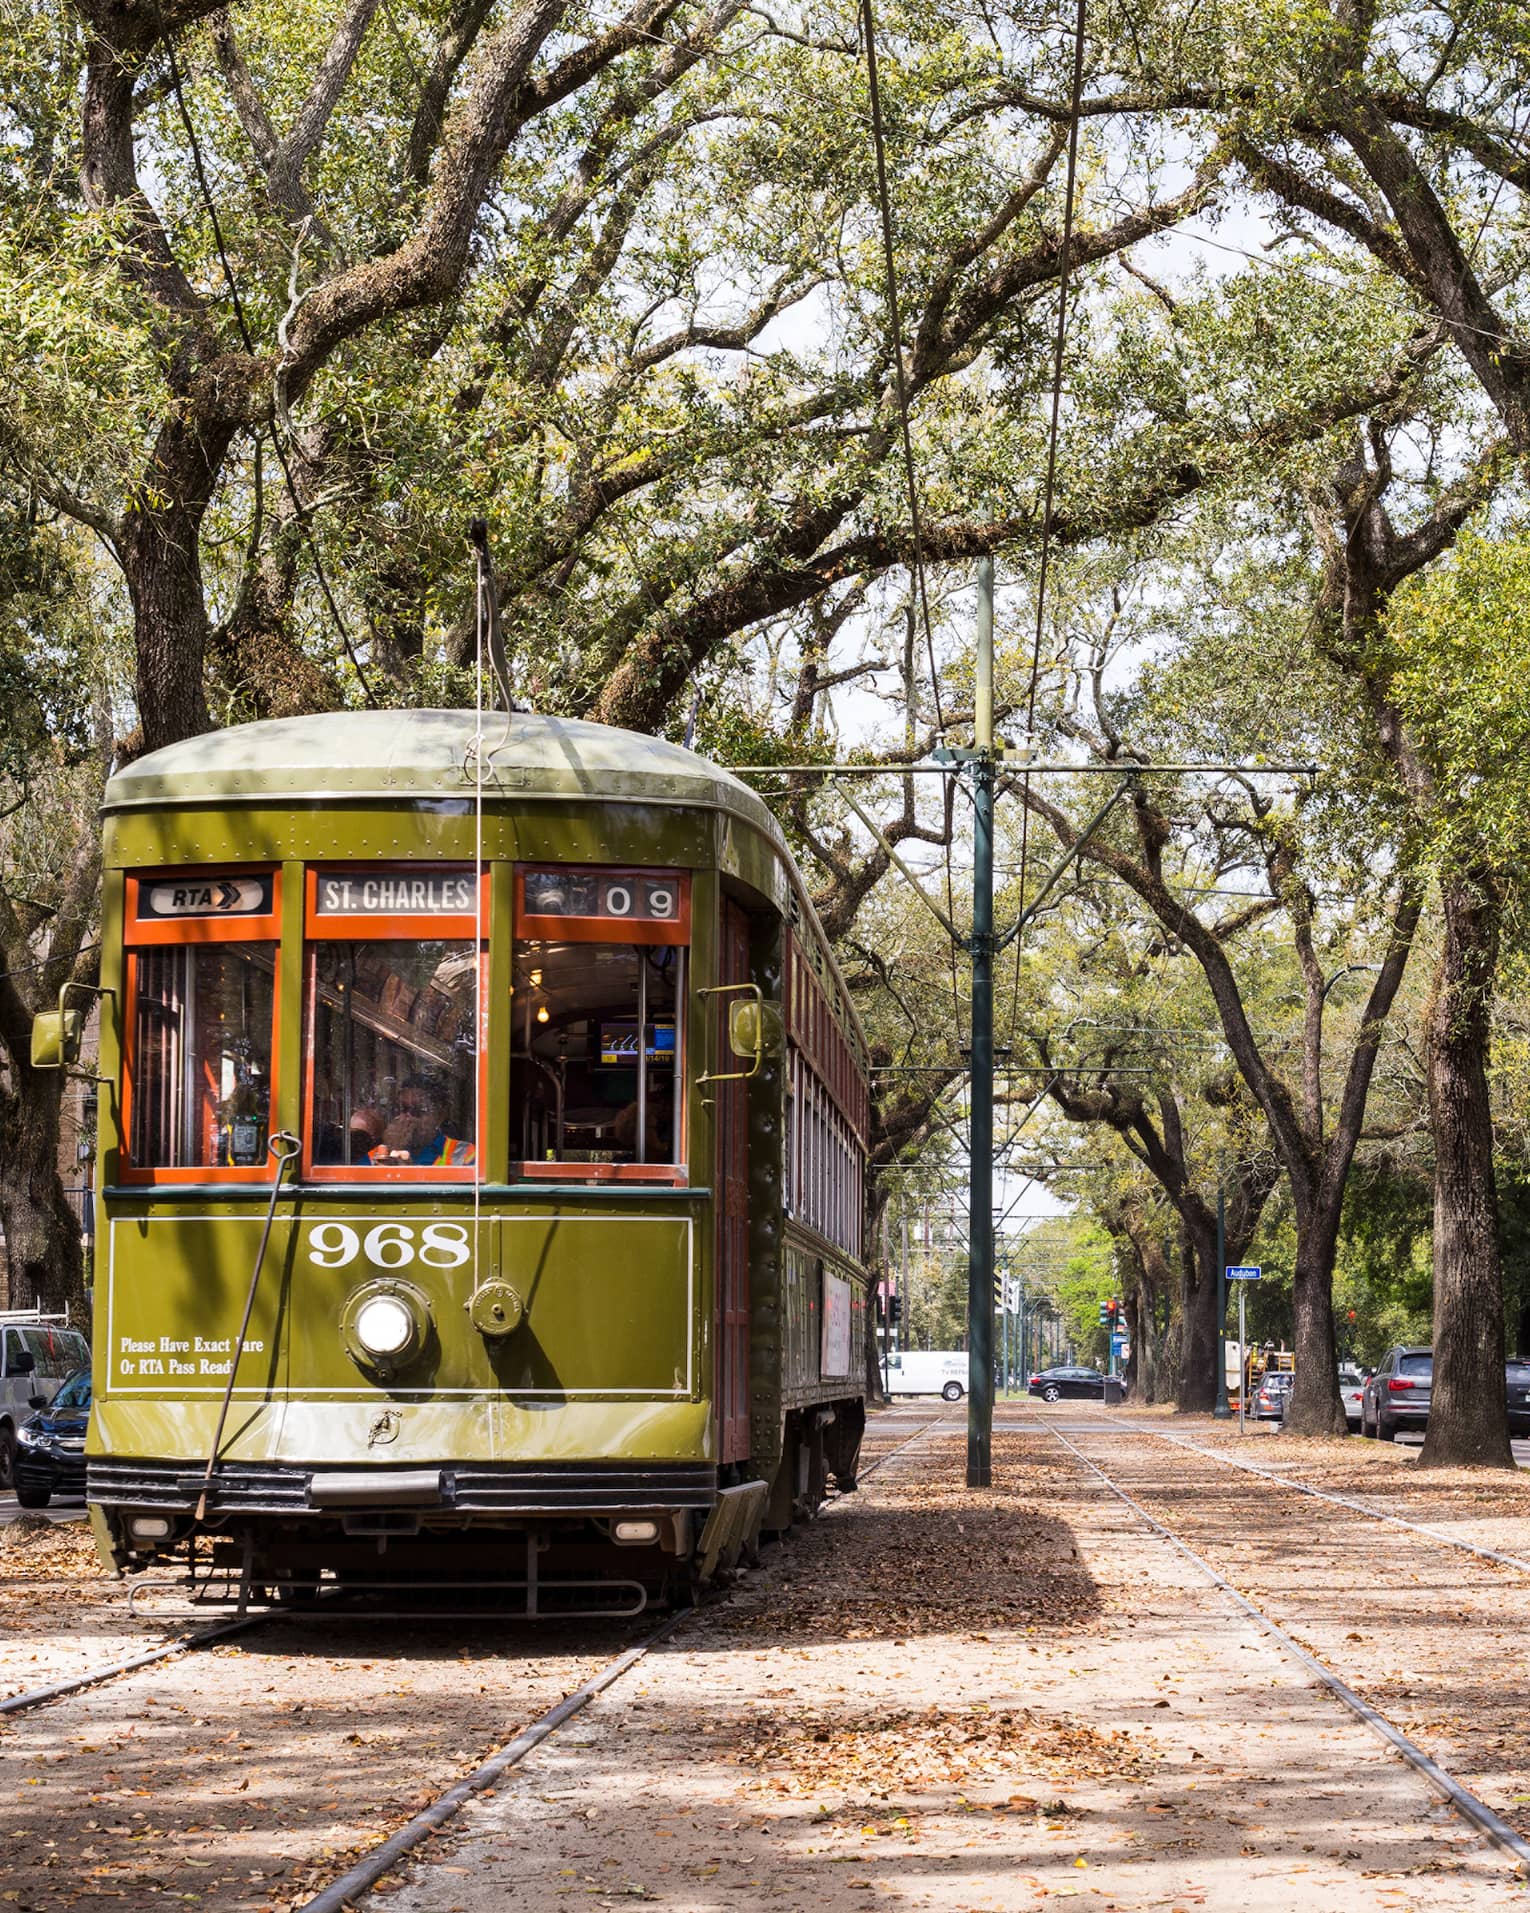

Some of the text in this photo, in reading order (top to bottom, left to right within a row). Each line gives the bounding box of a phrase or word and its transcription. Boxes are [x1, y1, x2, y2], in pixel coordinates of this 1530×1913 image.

[172, 888, 212, 906] RTA
[326, 880, 470, 910] ST. CHARLES
[309, 1223, 470, 1268] 968
[1231, 1268, 1258, 1278] Audubon
[120, 1337, 264, 1352] Please Have Exact are
[120, 1359, 235, 1374] Or RTA Pass Read
